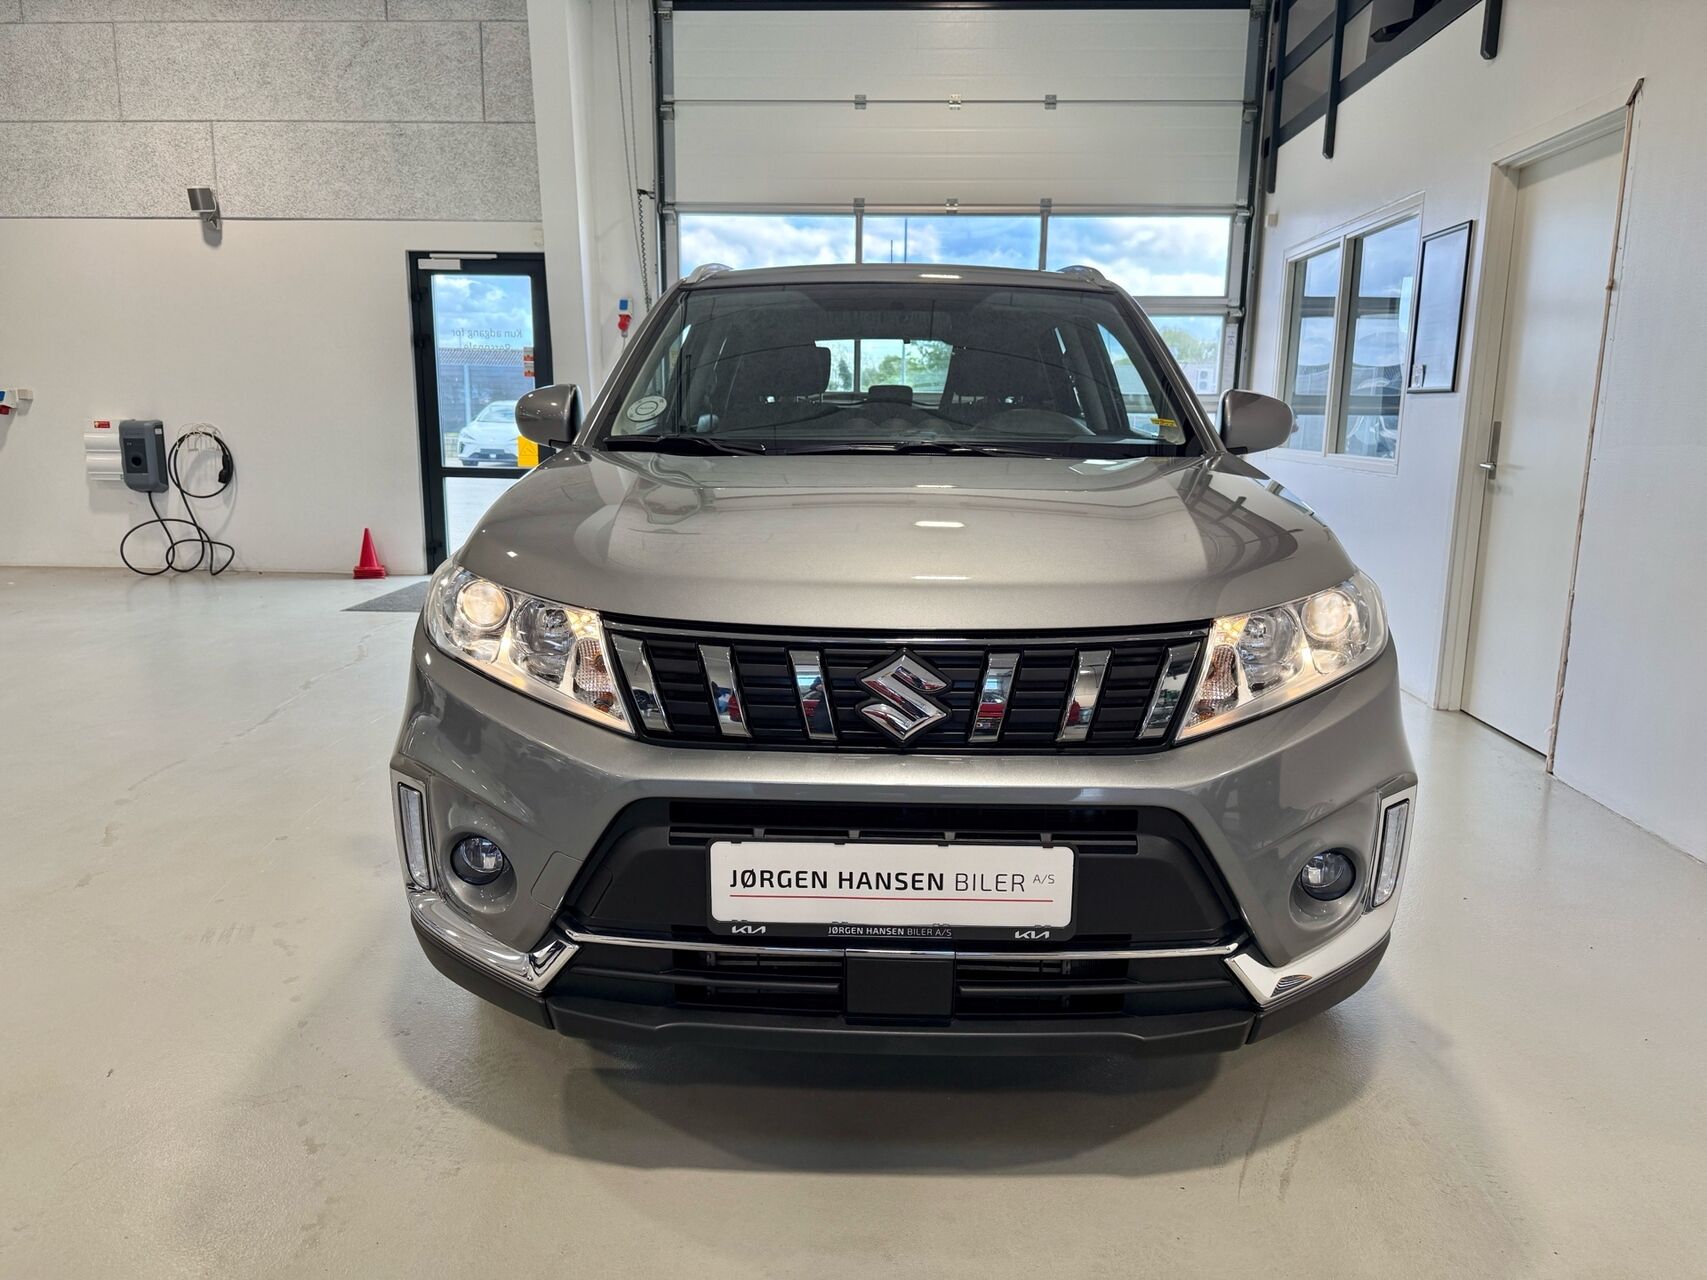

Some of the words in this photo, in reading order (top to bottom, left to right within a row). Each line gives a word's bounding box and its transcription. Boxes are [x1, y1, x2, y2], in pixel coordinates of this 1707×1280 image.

[729, 868, 828, 889] JØRGEN
[838, 871, 944, 891] HANSEN
[955, 872, 1025, 893] BILER
[1032, 874, 1055, 885] A/S
[827, 926, 864, 935] JØRGEN
[866, 927, 905, 936] HANSEN
[906, 928, 933, 936] BILER
[934, 928, 952, 937] A/S
